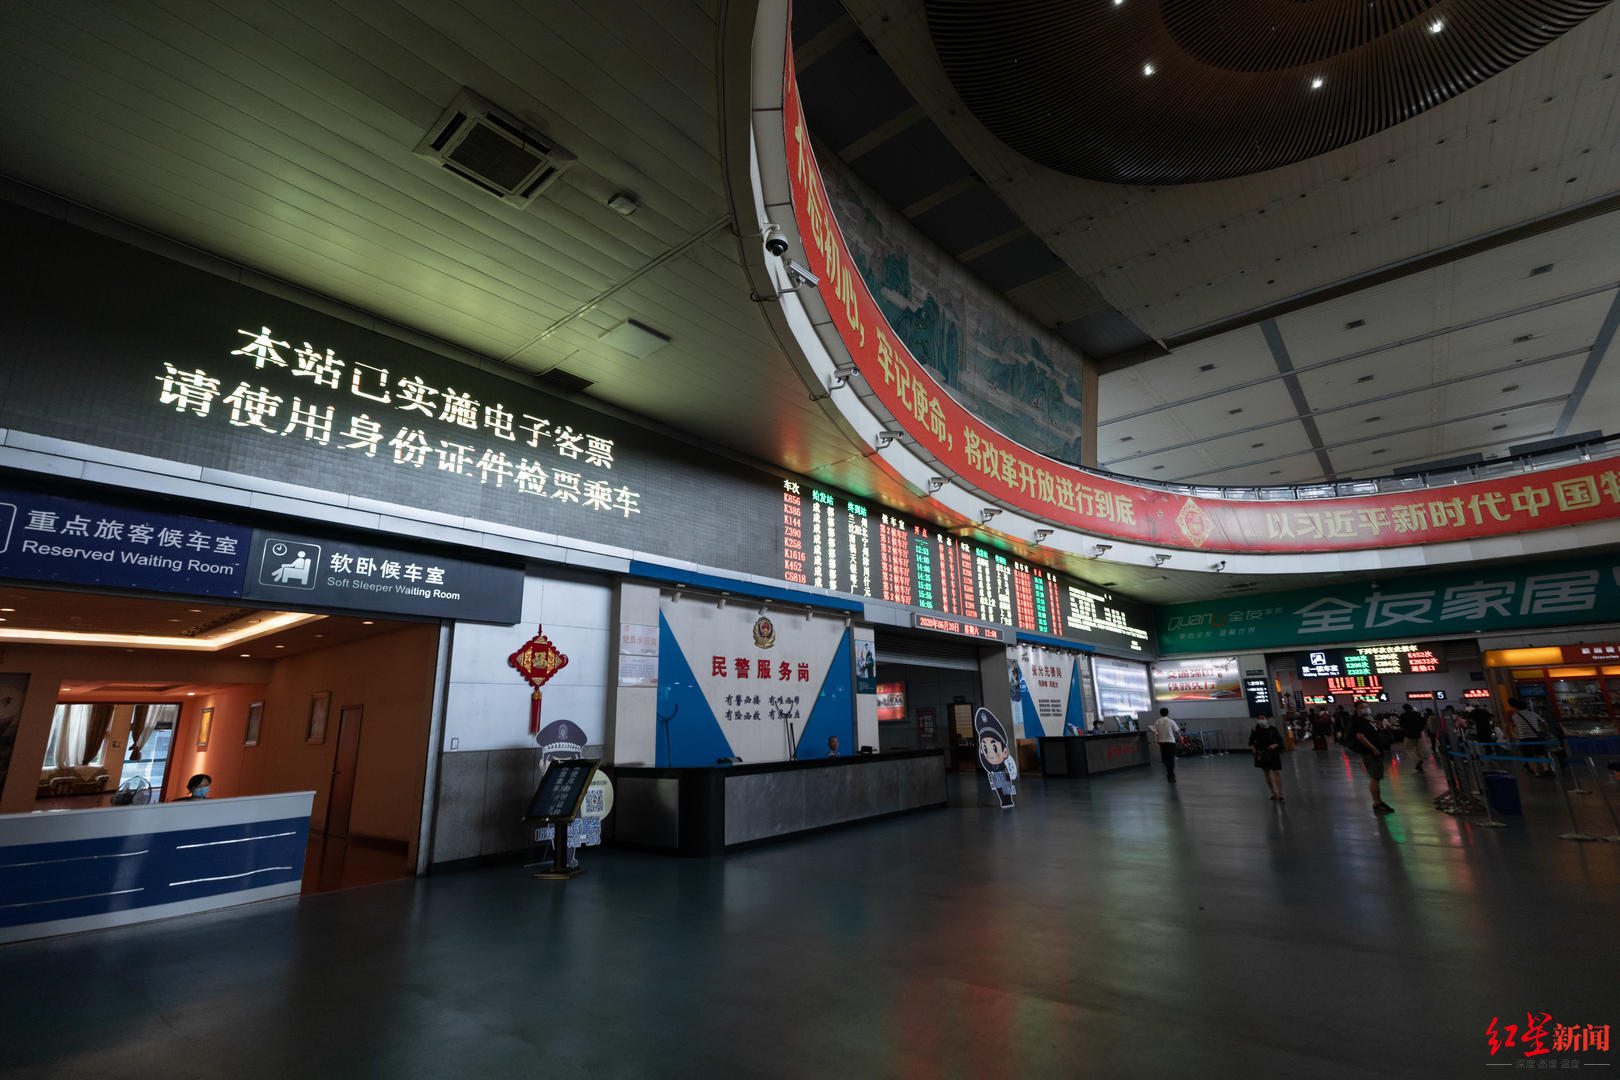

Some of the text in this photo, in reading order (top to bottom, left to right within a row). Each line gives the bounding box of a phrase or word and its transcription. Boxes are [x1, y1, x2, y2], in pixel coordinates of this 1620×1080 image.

[231, 326, 615, 470] 本站已实施电子客票
[156, 362, 642, 518] 请使用身份证件检票乘车
[784, 480, 800, 494] 车次
[812, 489, 834, 506] 始发站
[848, 502, 867, 517] 终到站
[784, 493, 800, 505] K856
[784, 504, 800, 516] K386
[24, 510, 238, 556] 重点旅客候车室
[784, 515, 800, 528] K144
[784, 526, 801, 538] Z390
[22, 540, 234, 575] Reserved Waiting Room
[330, 552, 446, 585] 软卧候车室
[785, 560, 802, 572] K452
[327, 576, 460, 600] Soft Sleeper Waiting Room
[1294, 570, 1600, 634] 全友家居
[712, 656, 809, 682] 民警服务岗
[1302, 664, 1340, 674] 第一候车室
[724, 694, 760, 706] 有警必接
[724, 708, 760, 720] 有险必救
